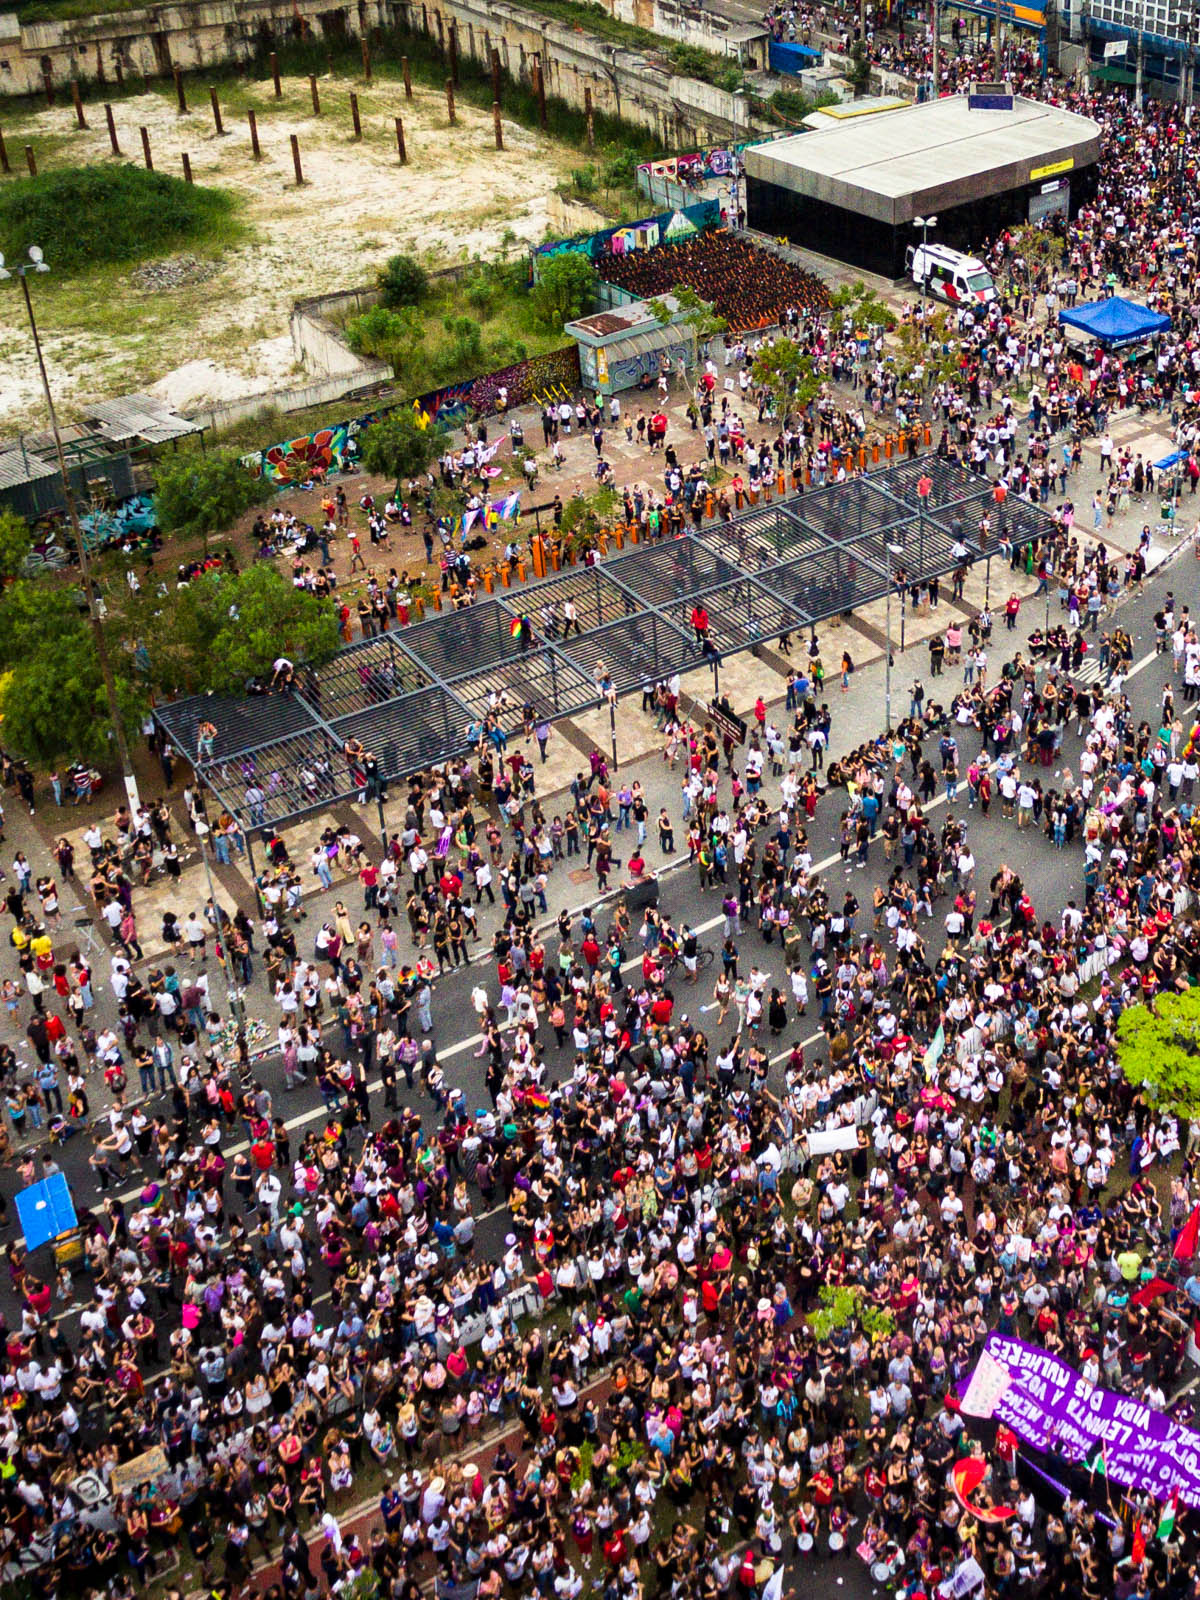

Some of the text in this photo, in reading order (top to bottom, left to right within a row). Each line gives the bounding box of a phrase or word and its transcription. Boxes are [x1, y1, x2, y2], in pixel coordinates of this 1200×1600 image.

[988, 1337, 1071, 1388] MULHERES
[1020, 1369, 1049, 1401] VOZ
[1050, 1388, 1066, 1407] A
[1073, 1379, 1104, 1411] DAS
[998, 1390, 1044, 1421] MENO
[1113, 1400, 1151, 1431] VIDA
[1066, 1398, 1132, 1446] LEVANTA
